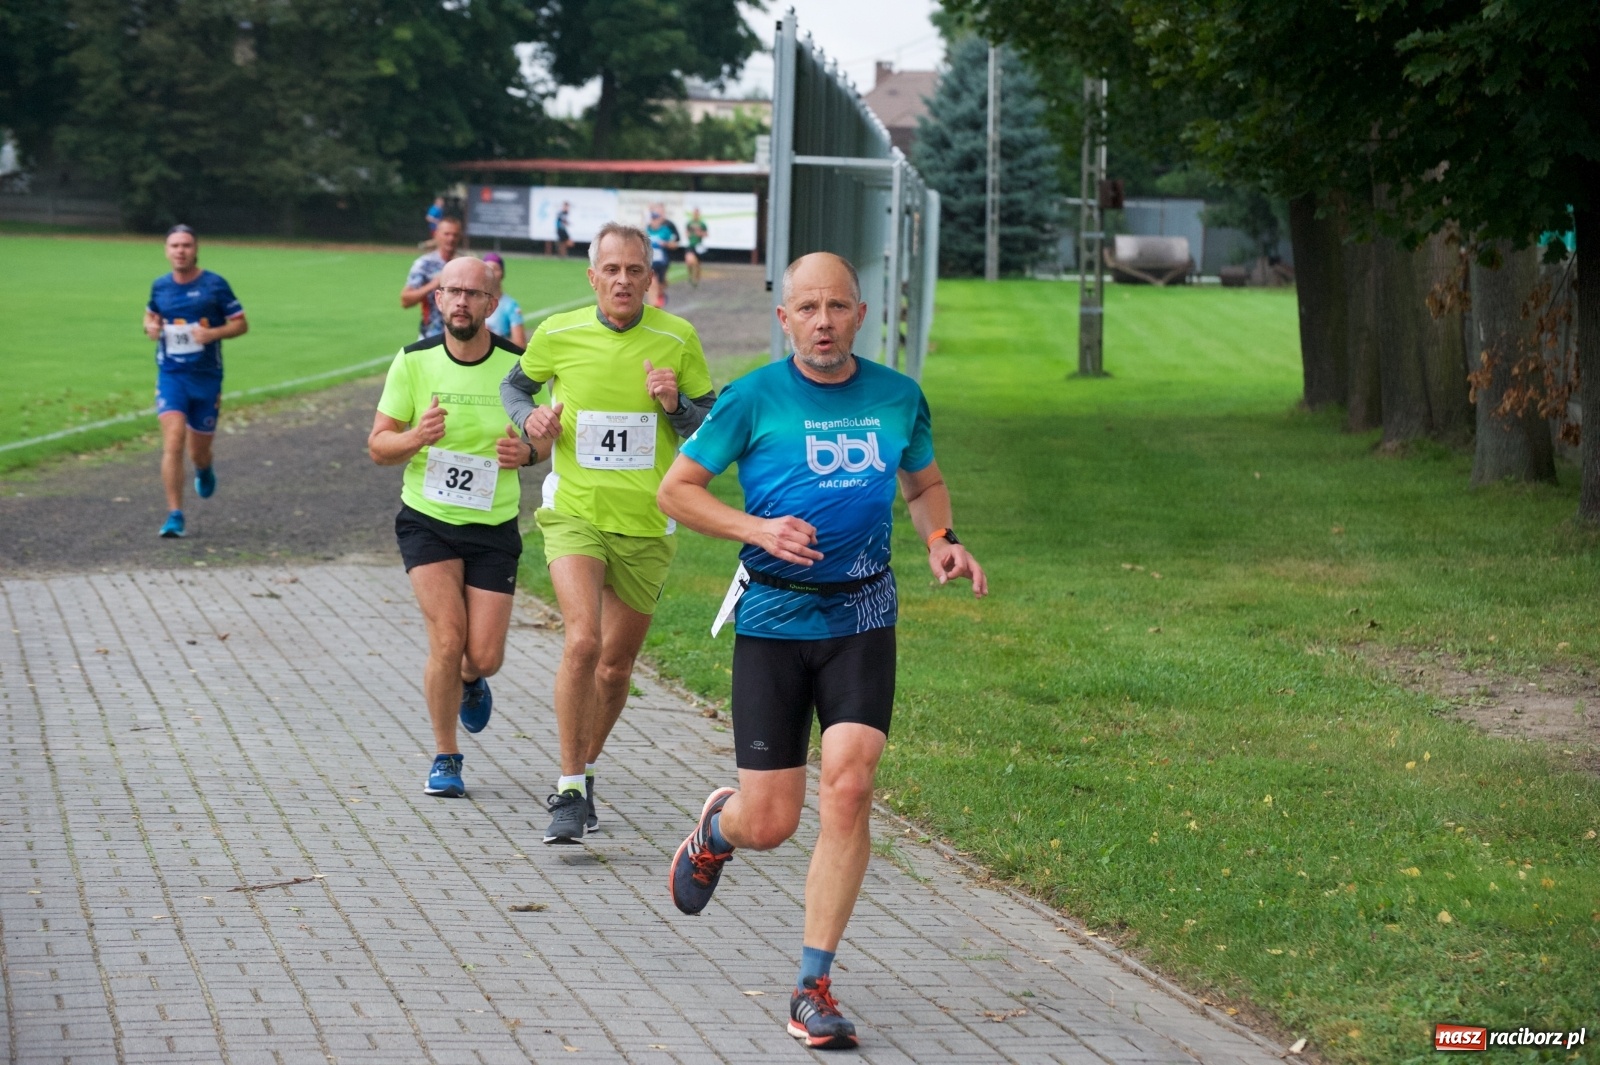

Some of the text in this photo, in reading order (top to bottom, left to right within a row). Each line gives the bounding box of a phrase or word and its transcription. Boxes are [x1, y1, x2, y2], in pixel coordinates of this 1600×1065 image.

[450, 395, 501, 406] RUNNING
[804, 417, 881, 430] BiegamBoLubię
[601, 429, 627, 452] 41
[805, 432, 886, 475] bbl
[445, 467, 473, 491] 32
[819, 478, 869, 488] RACIBÓRZ
